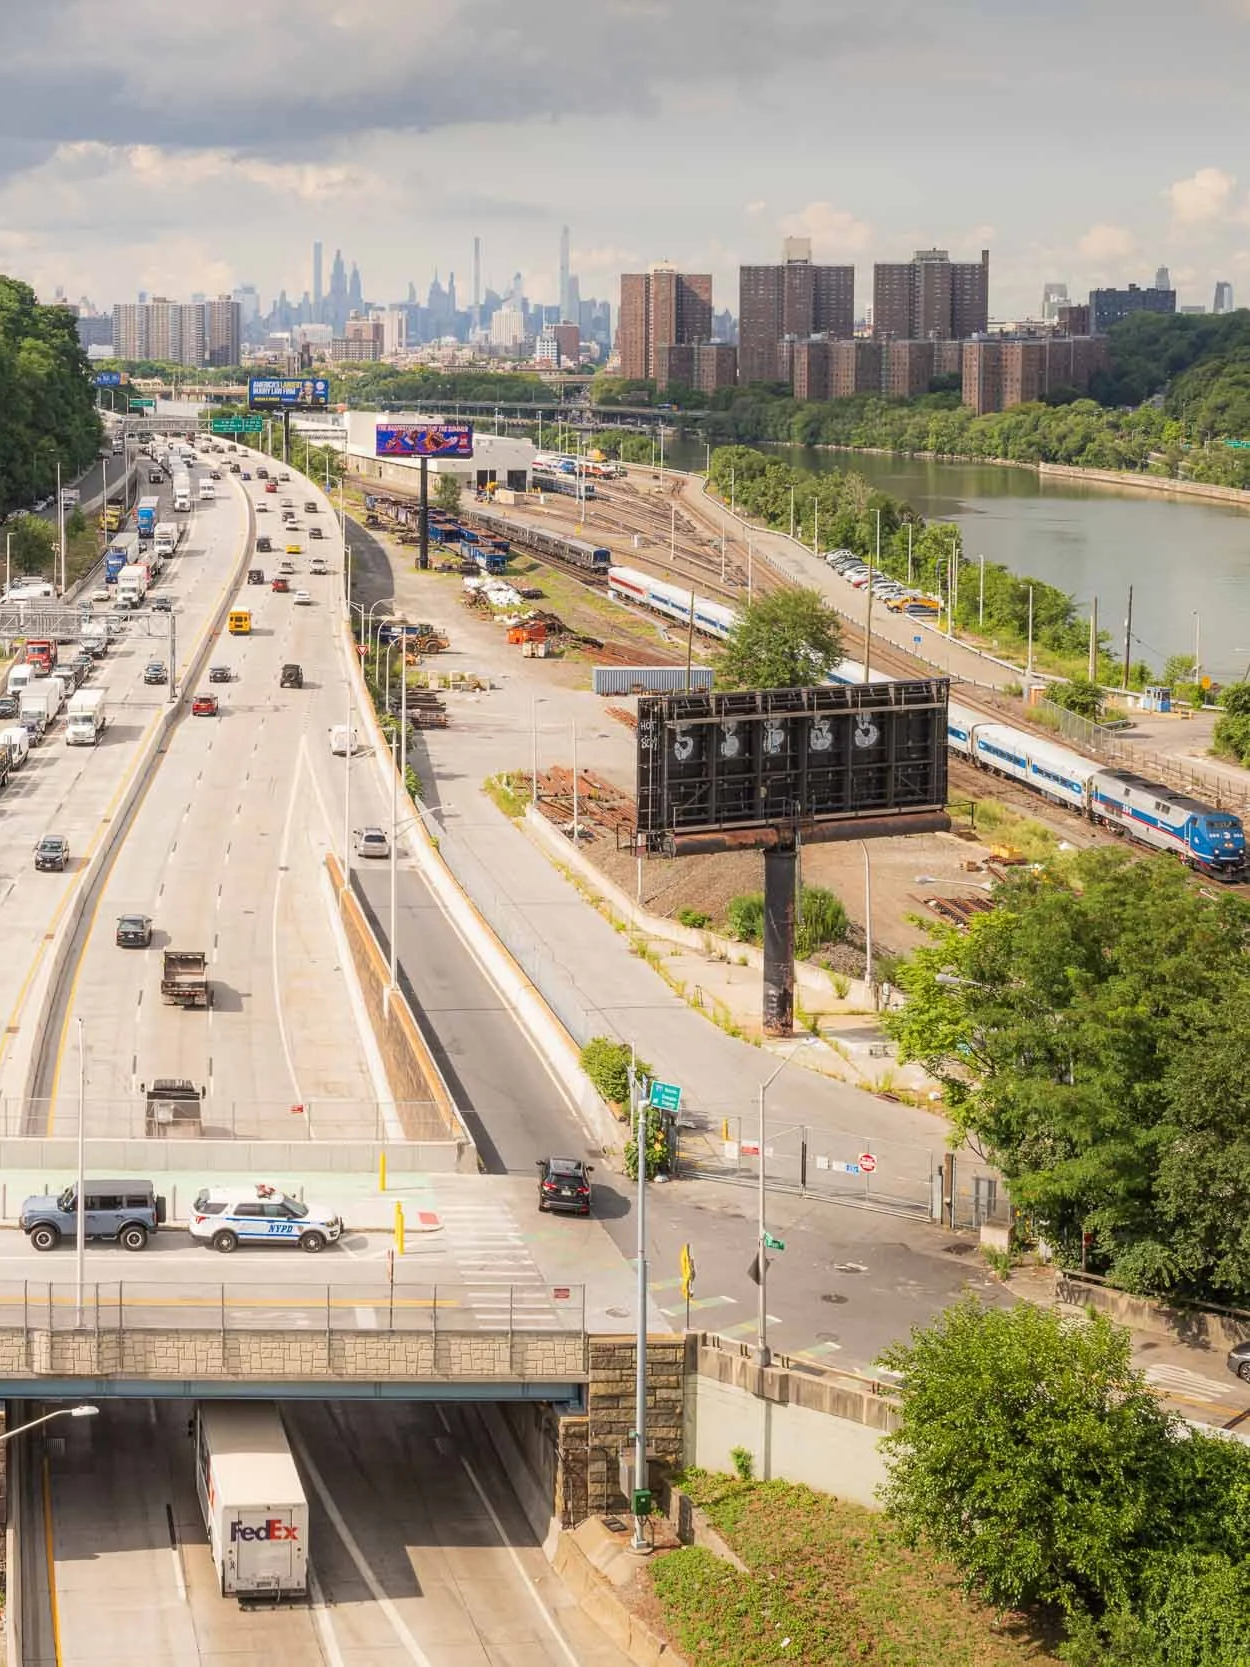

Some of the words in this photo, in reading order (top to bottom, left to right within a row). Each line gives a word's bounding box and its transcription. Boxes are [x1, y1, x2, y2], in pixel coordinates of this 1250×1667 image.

[640, 720, 657, 731] HOT
[268, 1224, 294, 1233] NYPD
[230, 1519, 299, 1542] FedEx
